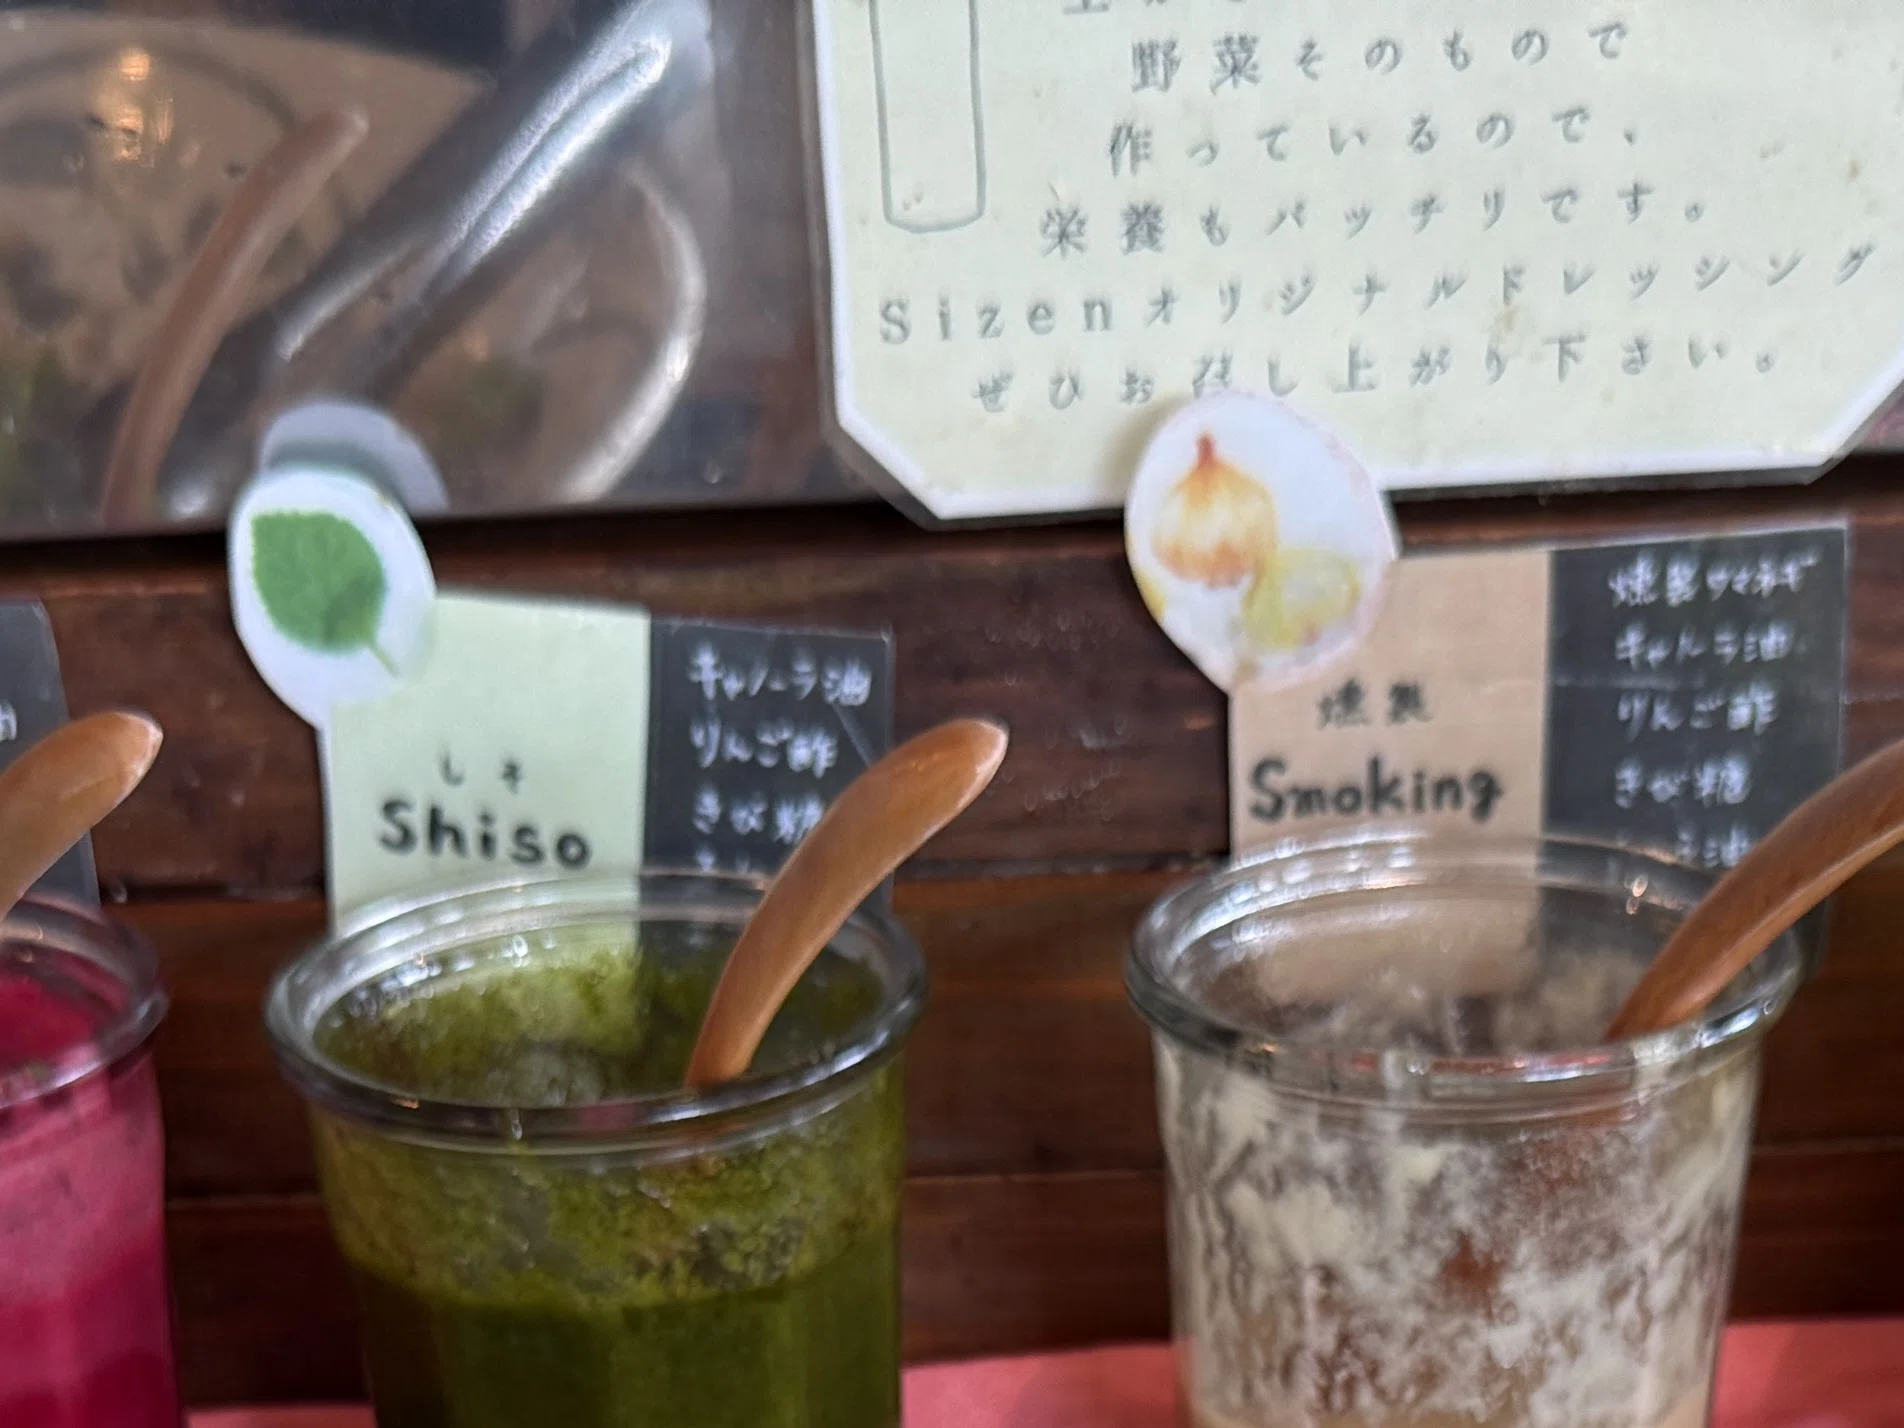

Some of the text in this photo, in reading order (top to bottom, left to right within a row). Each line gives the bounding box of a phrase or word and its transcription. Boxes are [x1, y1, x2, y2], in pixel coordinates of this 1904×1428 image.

[1130, 18, 1628, 95] 野菜そのもので
[1249, 753, 1503, 824] Smoking
[378, 796, 593, 873] Shiso
